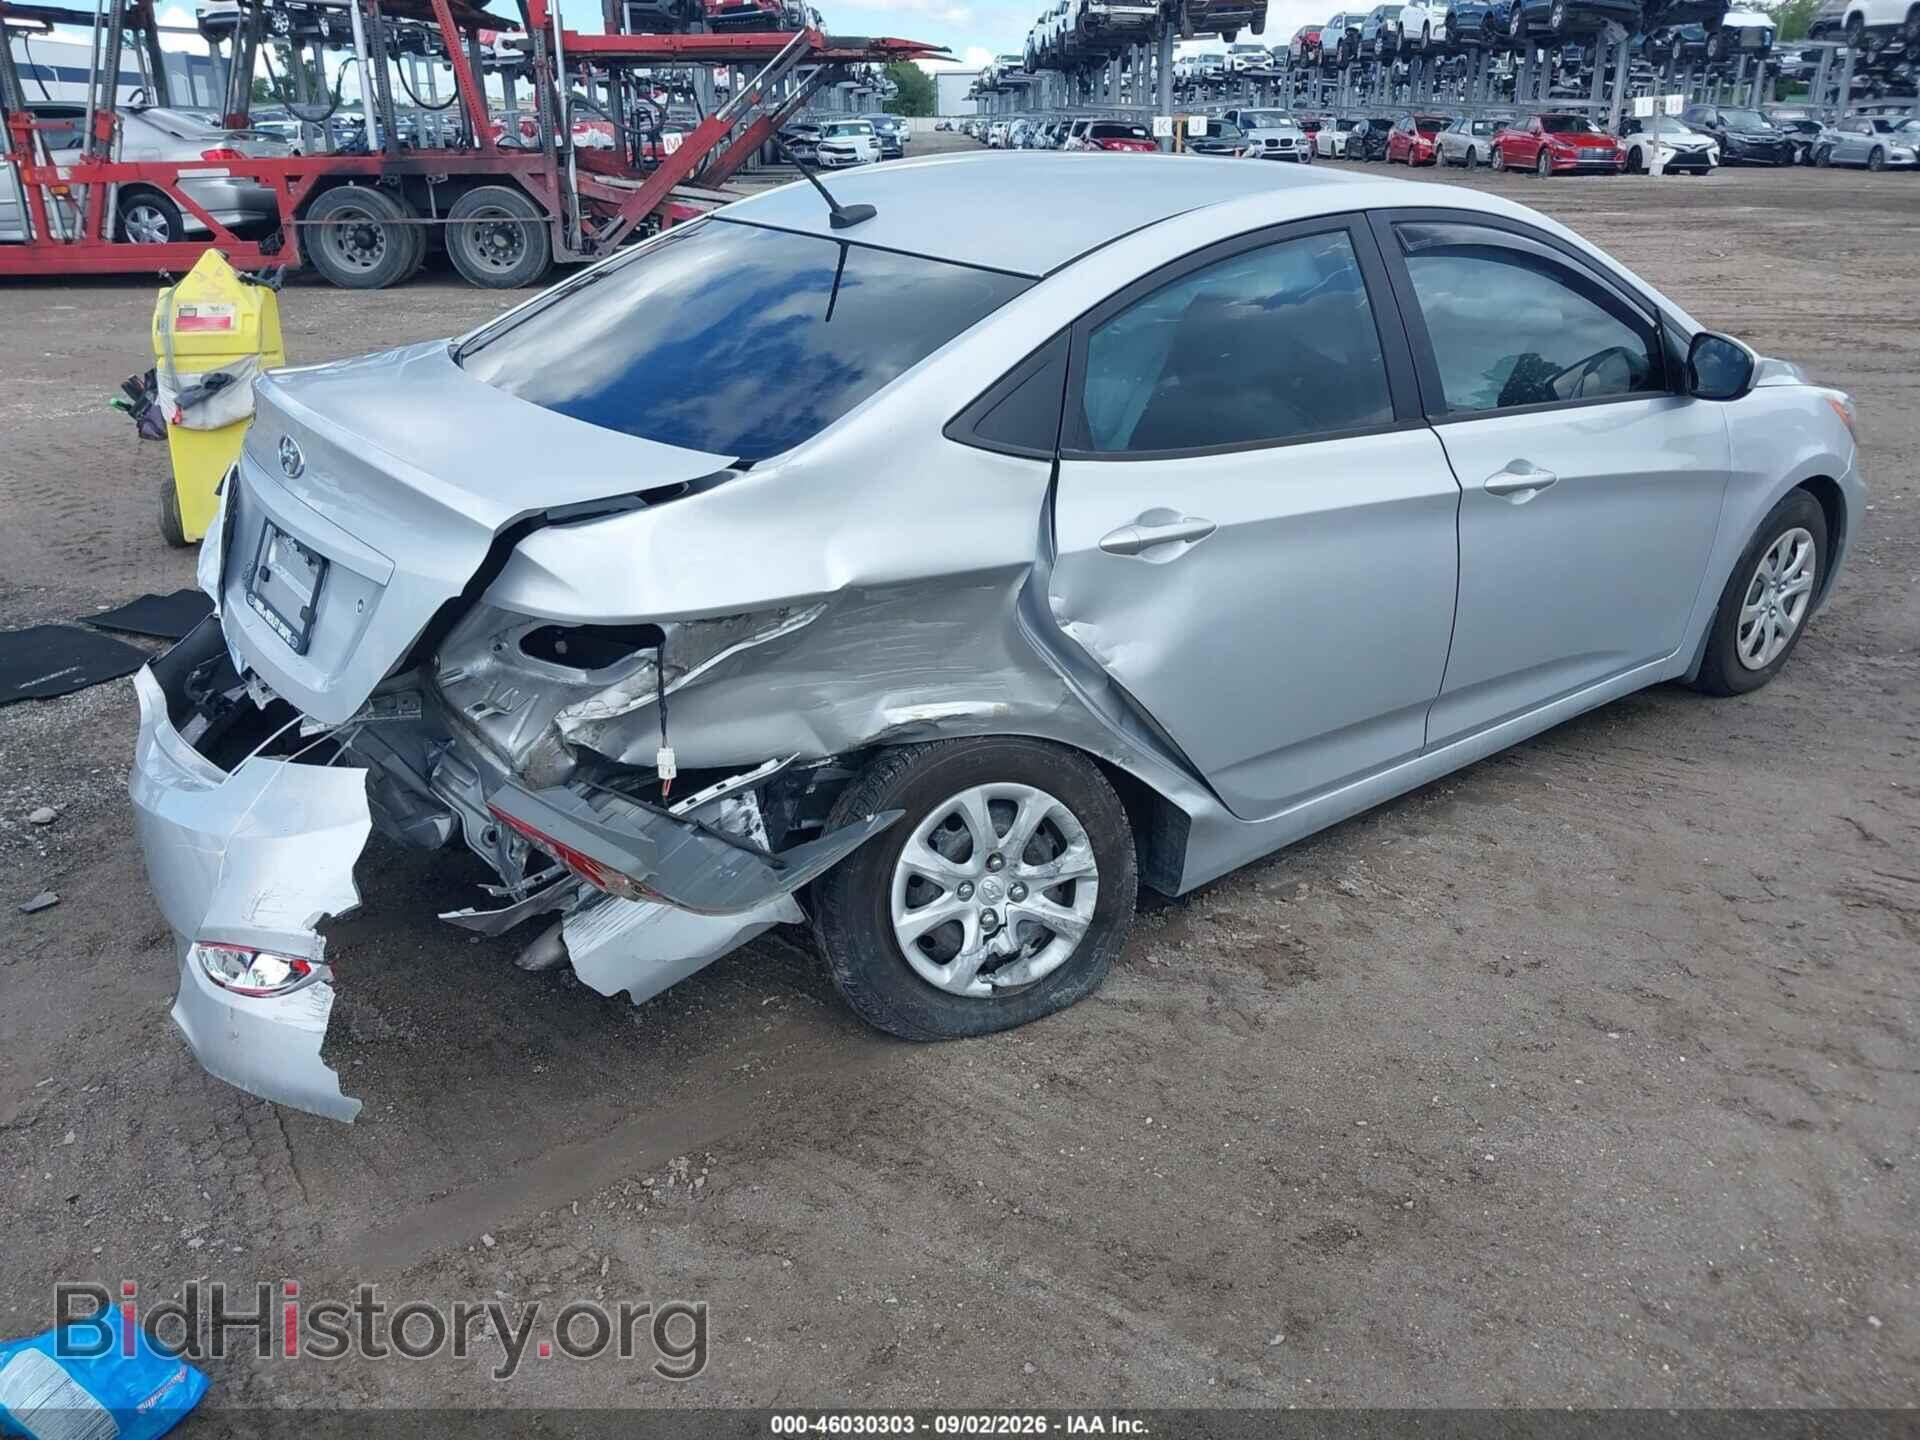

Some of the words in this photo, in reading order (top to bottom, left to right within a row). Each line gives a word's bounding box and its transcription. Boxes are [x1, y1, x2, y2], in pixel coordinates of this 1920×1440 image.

[1158, 120, 1167, 133] K
[1192, 119, 1200, 132] J
[666, 136, 680, 151] M
